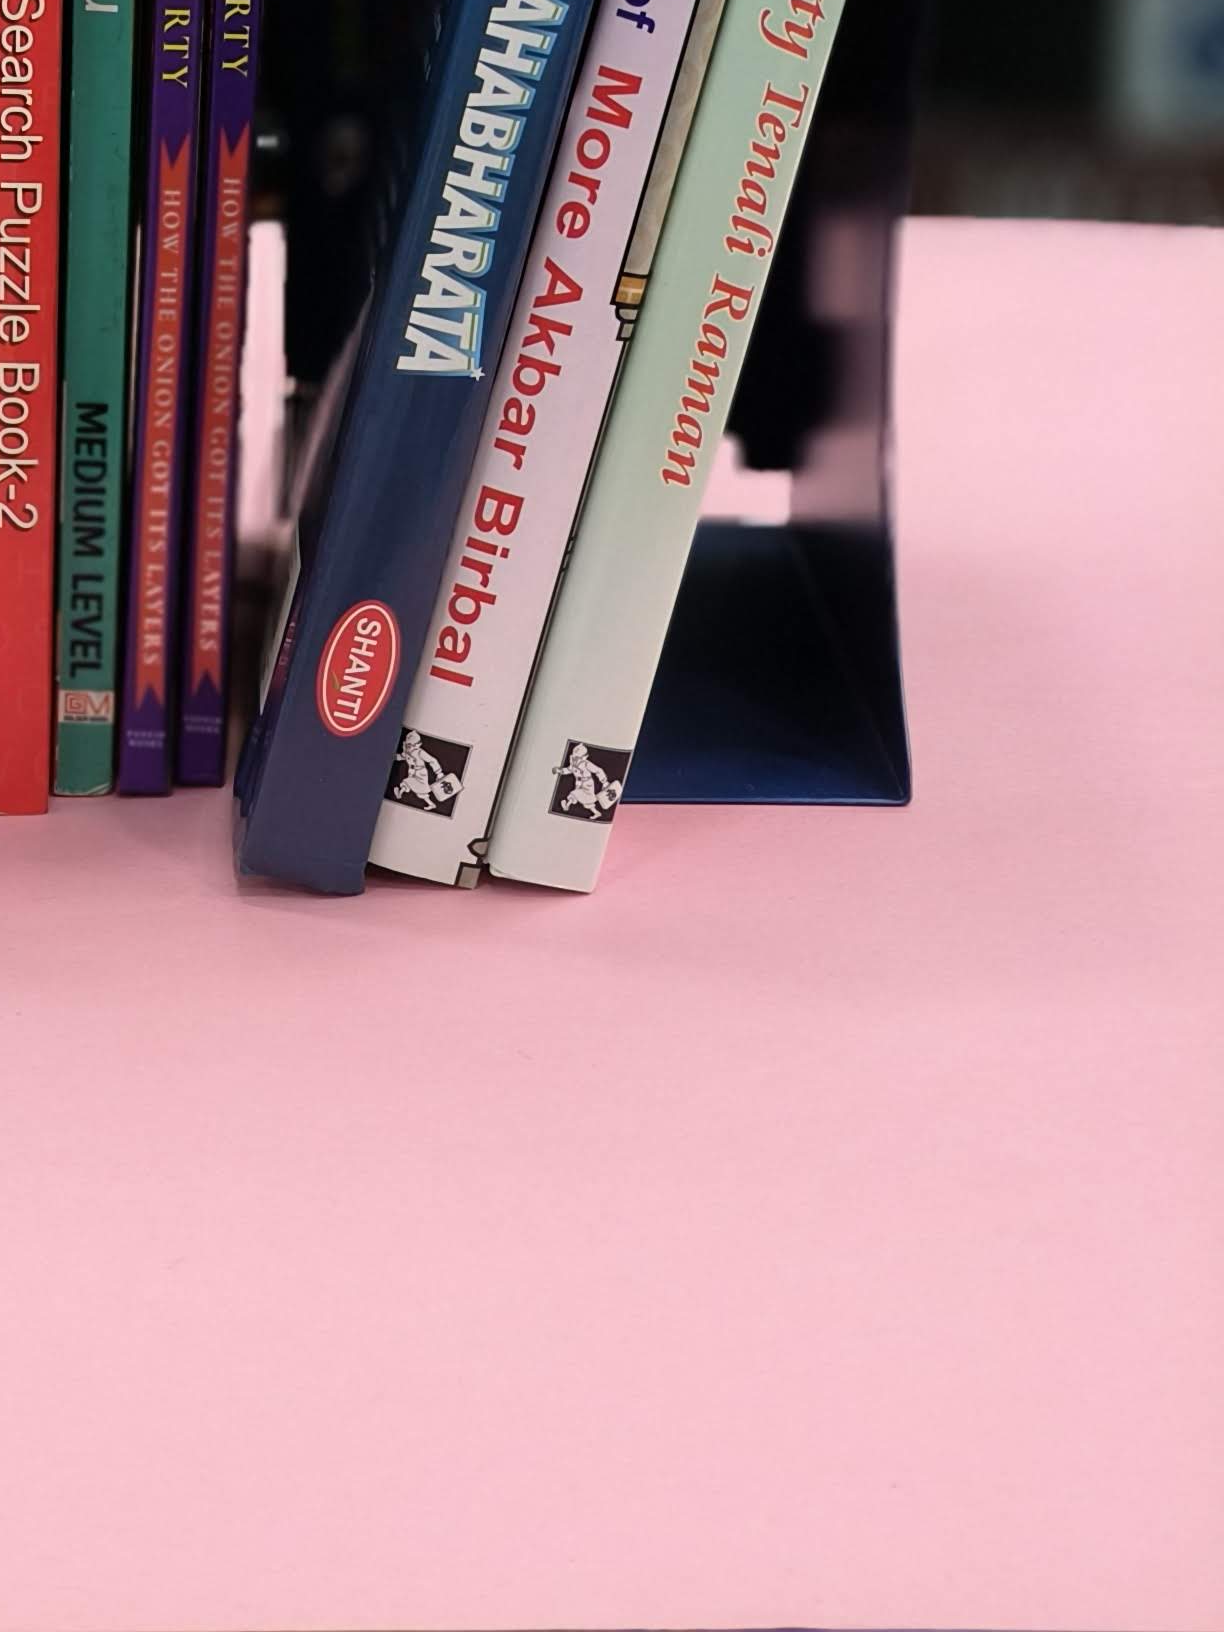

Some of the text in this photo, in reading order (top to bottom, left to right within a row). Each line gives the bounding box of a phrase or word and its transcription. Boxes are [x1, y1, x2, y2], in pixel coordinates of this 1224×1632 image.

[555, 64, 643, 240] More
[722, 82, 812, 263] Tenali
[161, 189, 182, 253] HOW
[222, 178, 242, 241] HOW
[159, 268, 179, 321] THE
[216, 258, 237, 309] THE
[153, 334, 176, 429] ONION
[212, 321, 234, 414] ONION
[490, 256, 584, 471] Akbar
[658, 273, 756, 489] Raman
[71, 402, 110, 557] MEDIUM
[150, 440, 171, 496] GOT
[68, 573, 105, 678] LEVEL
[143, 564, 165, 665] LAYERS
[199, 550, 222, 652] LAYERS
[429, 484, 527, 688] Birbal
[333, 617, 382, 721] SHANTI
